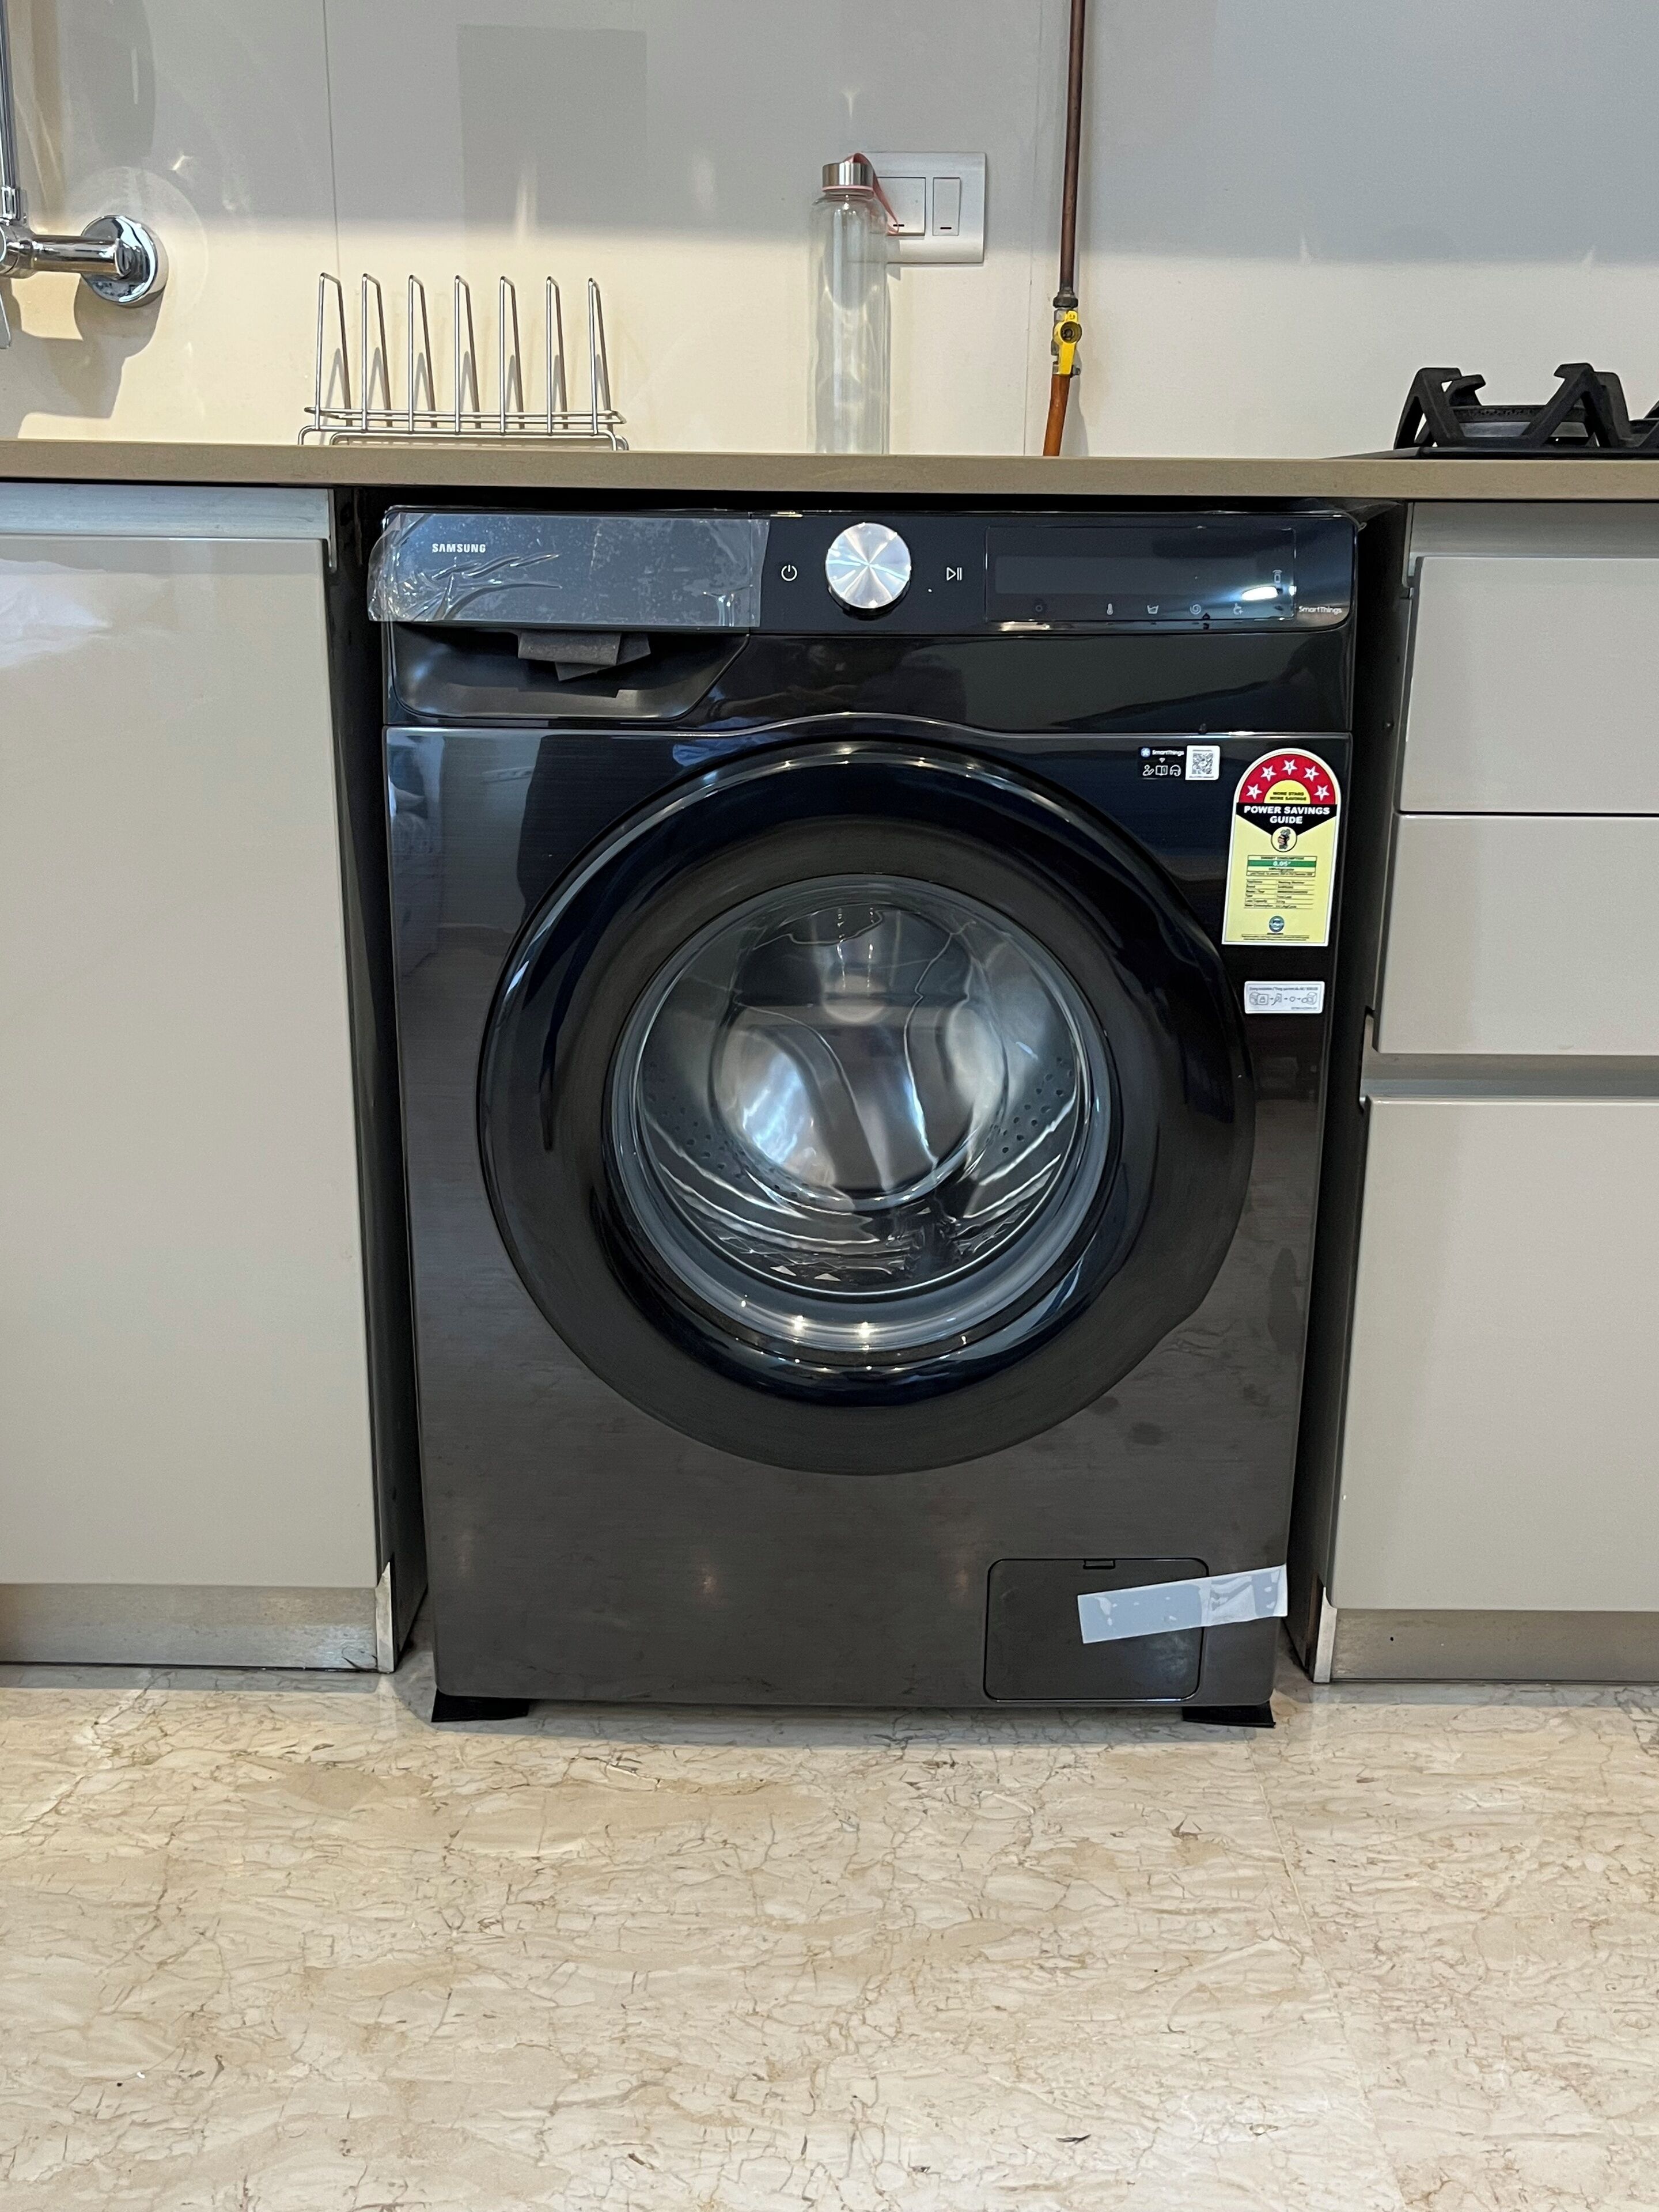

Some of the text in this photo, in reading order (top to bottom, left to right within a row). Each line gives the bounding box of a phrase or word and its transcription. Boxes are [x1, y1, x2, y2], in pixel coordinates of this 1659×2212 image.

[432, 543, 486, 553] SAMSUNG
[1298, 606, 1342, 615] SmartThings
[1244, 805, 1330, 815] POWER SAVINGS
[1270, 816, 1303, 824] GUIDE
